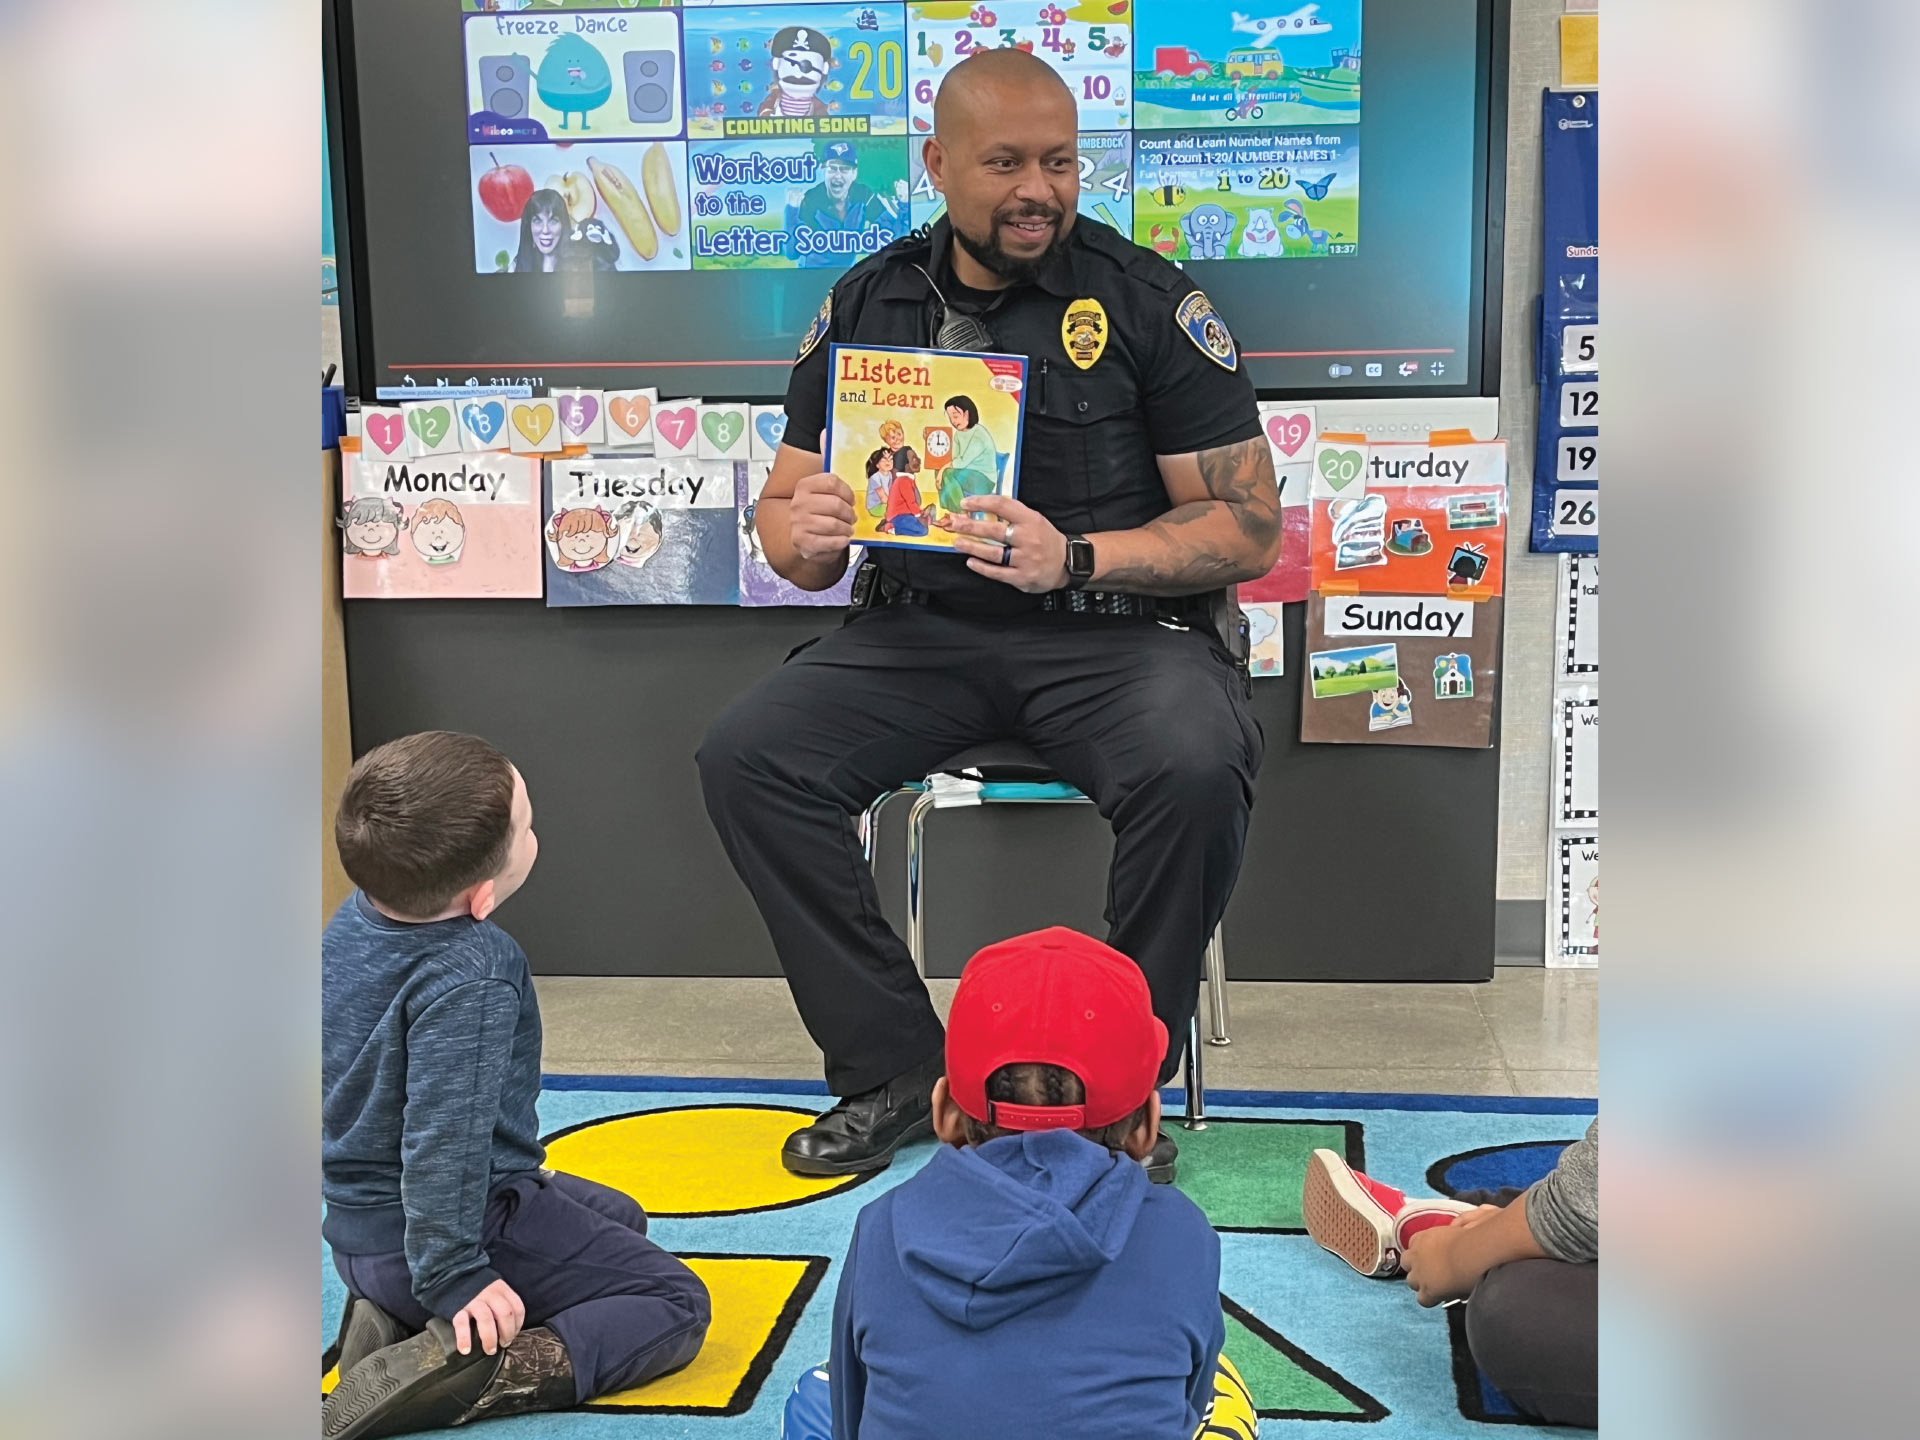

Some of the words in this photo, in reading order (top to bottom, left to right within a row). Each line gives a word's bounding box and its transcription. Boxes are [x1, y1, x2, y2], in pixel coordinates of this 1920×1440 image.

[496, 15, 559, 35] Freeze
[917, 31, 927, 56] 1
[954, 30, 973, 55] 2
[998, 28, 1017, 49] 3
[1041, 28, 1061, 52] 4
[1088, 26, 1106, 51] 5
[848, 40, 902, 100] 20
[914, 79, 934, 104] 6
[1083, 75, 1111, 100] 10
[1191, 93, 1206, 102] And
[1209, 94, 1219, 102] we
[1223, 93, 1233, 101] all
[726, 118, 815, 134] COUNTING
[819, 117, 868, 133] SONG
[1139, 138, 1171, 150] Count
[1173, 137, 1194, 149] and
[1196, 137, 1226, 149] Learn
[1228, 136, 1272, 148] Number
[1274, 135, 1313, 147] Names
[1315, 134, 1341, 146] from
[694, 153, 817, 183] Workout
[1235, 151, 1284, 163] NUMBER
[1286, 150, 1328, 162] NAMES
[911, 170, 936, 200] 4
[1101, 170, 1129, 202] 4
[1238, 174, 1254, 184] to
[1258, 168, 1290, 190] 20
[696, 193, 721, 215] to
[725, 191, 766, 214] the
[696, 227, 788, 255] Letter
[795, 224, 894, 254] Sounds
[1329, 245, 1356, 254] 13:37
[1578, 335, 1595, 361] 5
[840, 355, 931, 387] Listen
[1368, 366, 1379, 374] CC
[839, 390, 867, 403] and
[872, 387, 934, 410] Learn
[1569, 390, 1598, 417] 12
[424, 418, 439, 438] 2
[526, 415, 540, 435] 4
[570, 405, 585, 428] 5
[626, 407, 639, 428] 6
[383, 424, 393, 446] 1
[671, 419, 685, 441] 7
[718, 423, 731, 443] 8
[770, 423, 784, 443] 9
[1277, 424, 1302, 446] 19
[1324, 459, 1355, 480] 20
[1366, 452, 1469, 484] turday
[1566, 446, 1597, 471] 19
[383, 464, 506, 501] Monday
[568, 468, 705, 505] Tuesday
[1559, 500, 1596, 525] 26
[1341, 602, 1465, 637] Sunday
